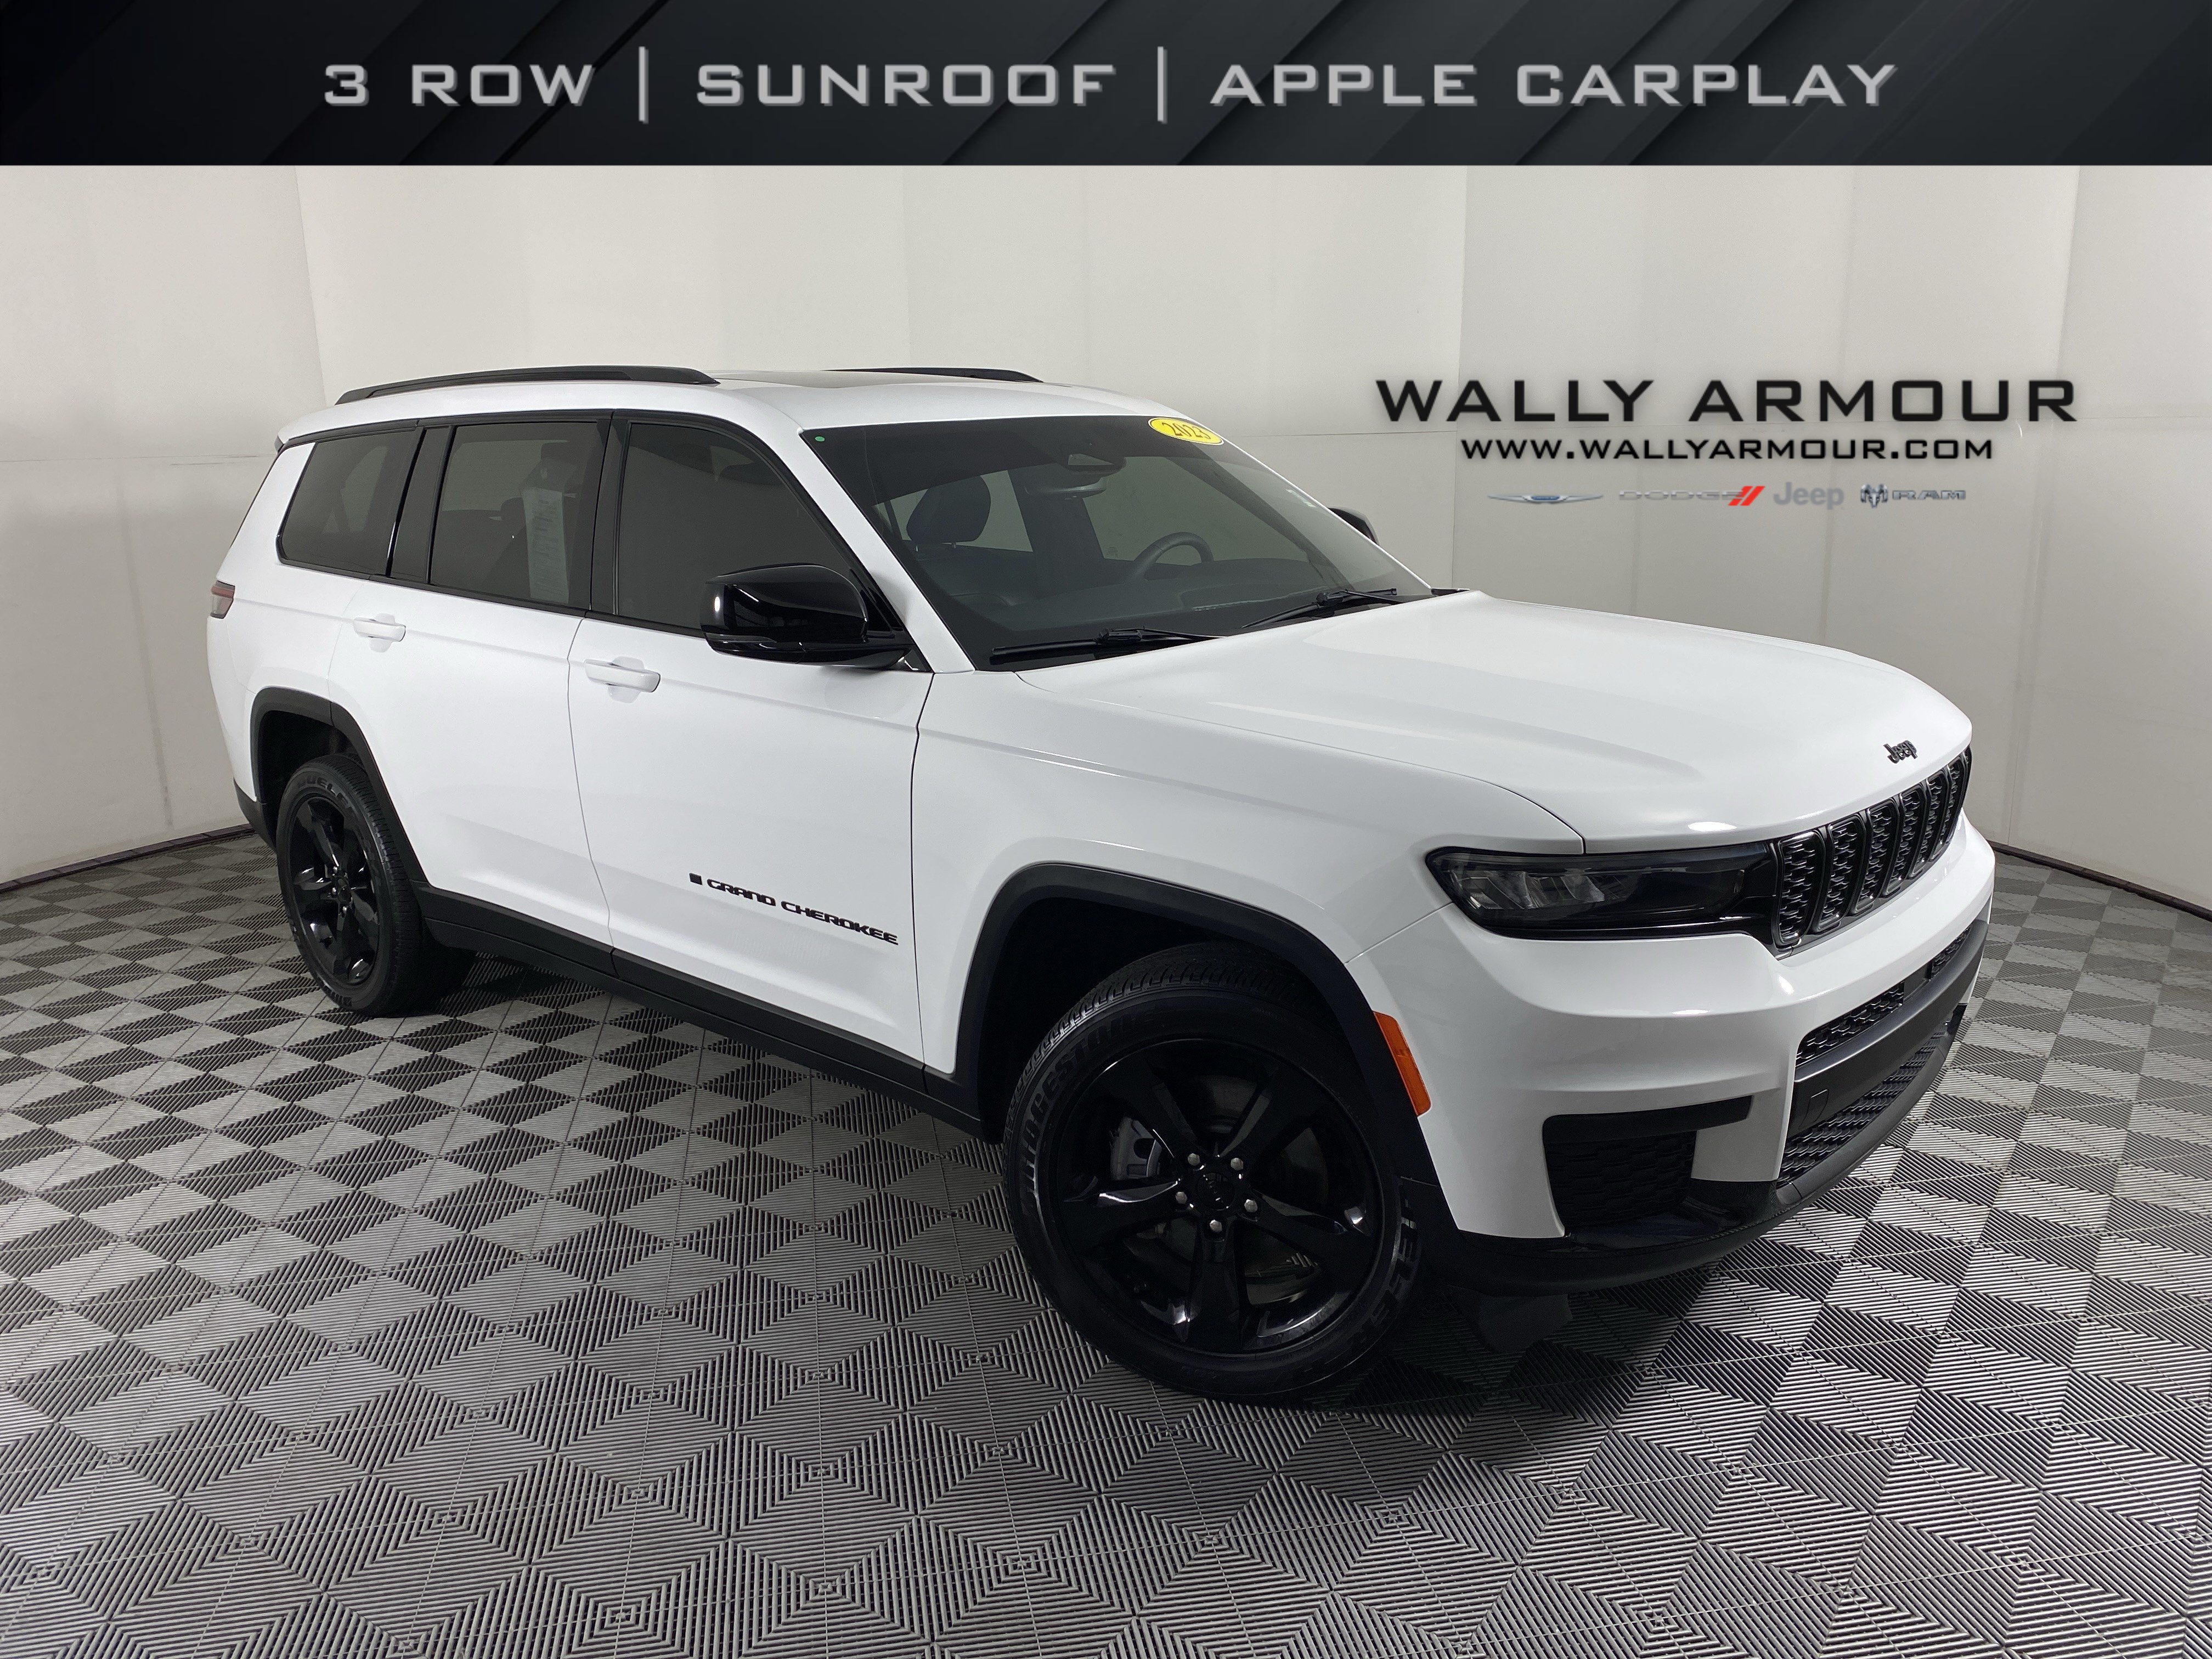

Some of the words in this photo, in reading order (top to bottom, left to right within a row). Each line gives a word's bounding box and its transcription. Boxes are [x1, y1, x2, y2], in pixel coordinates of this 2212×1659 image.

[1161, 422, 1211, 440] 2023
[1883, 740, 1918, 764] Jeep
[707, 878, 776, 906] GRAND
[781, 900, 899, 945] CHEROKEE
